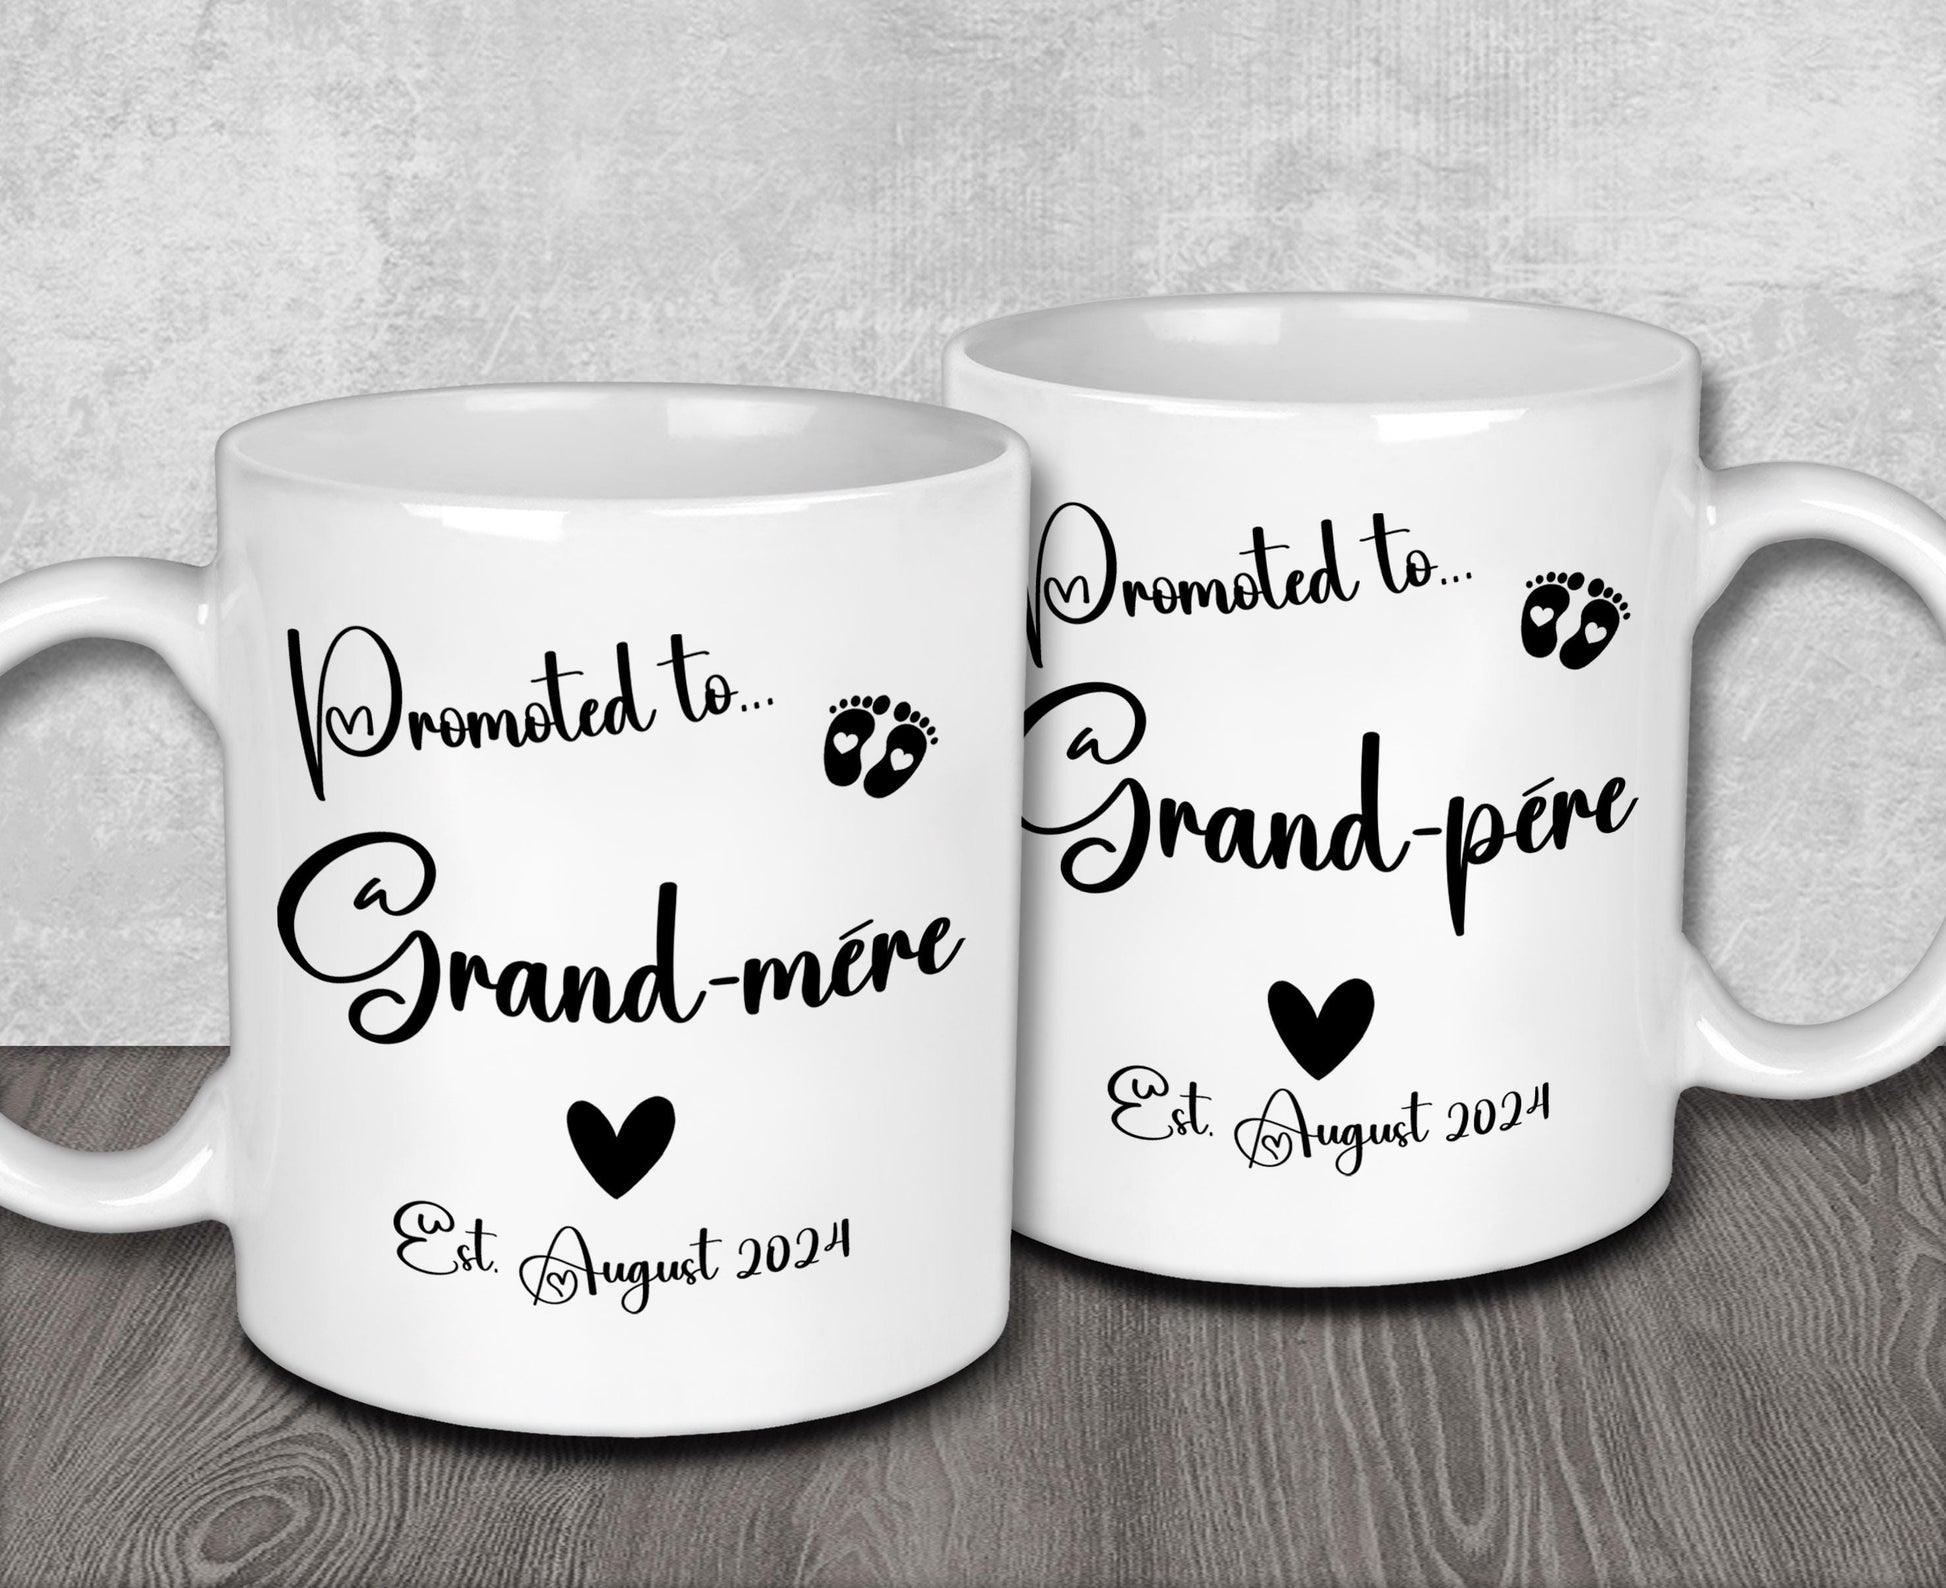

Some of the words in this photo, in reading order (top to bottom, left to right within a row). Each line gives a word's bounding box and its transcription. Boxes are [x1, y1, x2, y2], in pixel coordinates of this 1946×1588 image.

[1026, 502, 1359, 668] Promoted
[1360, 513, 1472, 593] to...
[287, 625, 656, 801] Promoted
[657, 634, 775, 722] to...
[1021, 682, 1638, 936] Grand-pére
[277, 832, 966, 1045] Grand-mére
[1108, 1066, 1214, 1140] Est.
[1234, 1089, 1432, 1176] August
[1446, 1083, 1549, 1141] 2024
[394, 1201, 499, 1275] Est.
[519, 1226, 721, 1314] August
[737, 1219, 850, 1279] 2024
